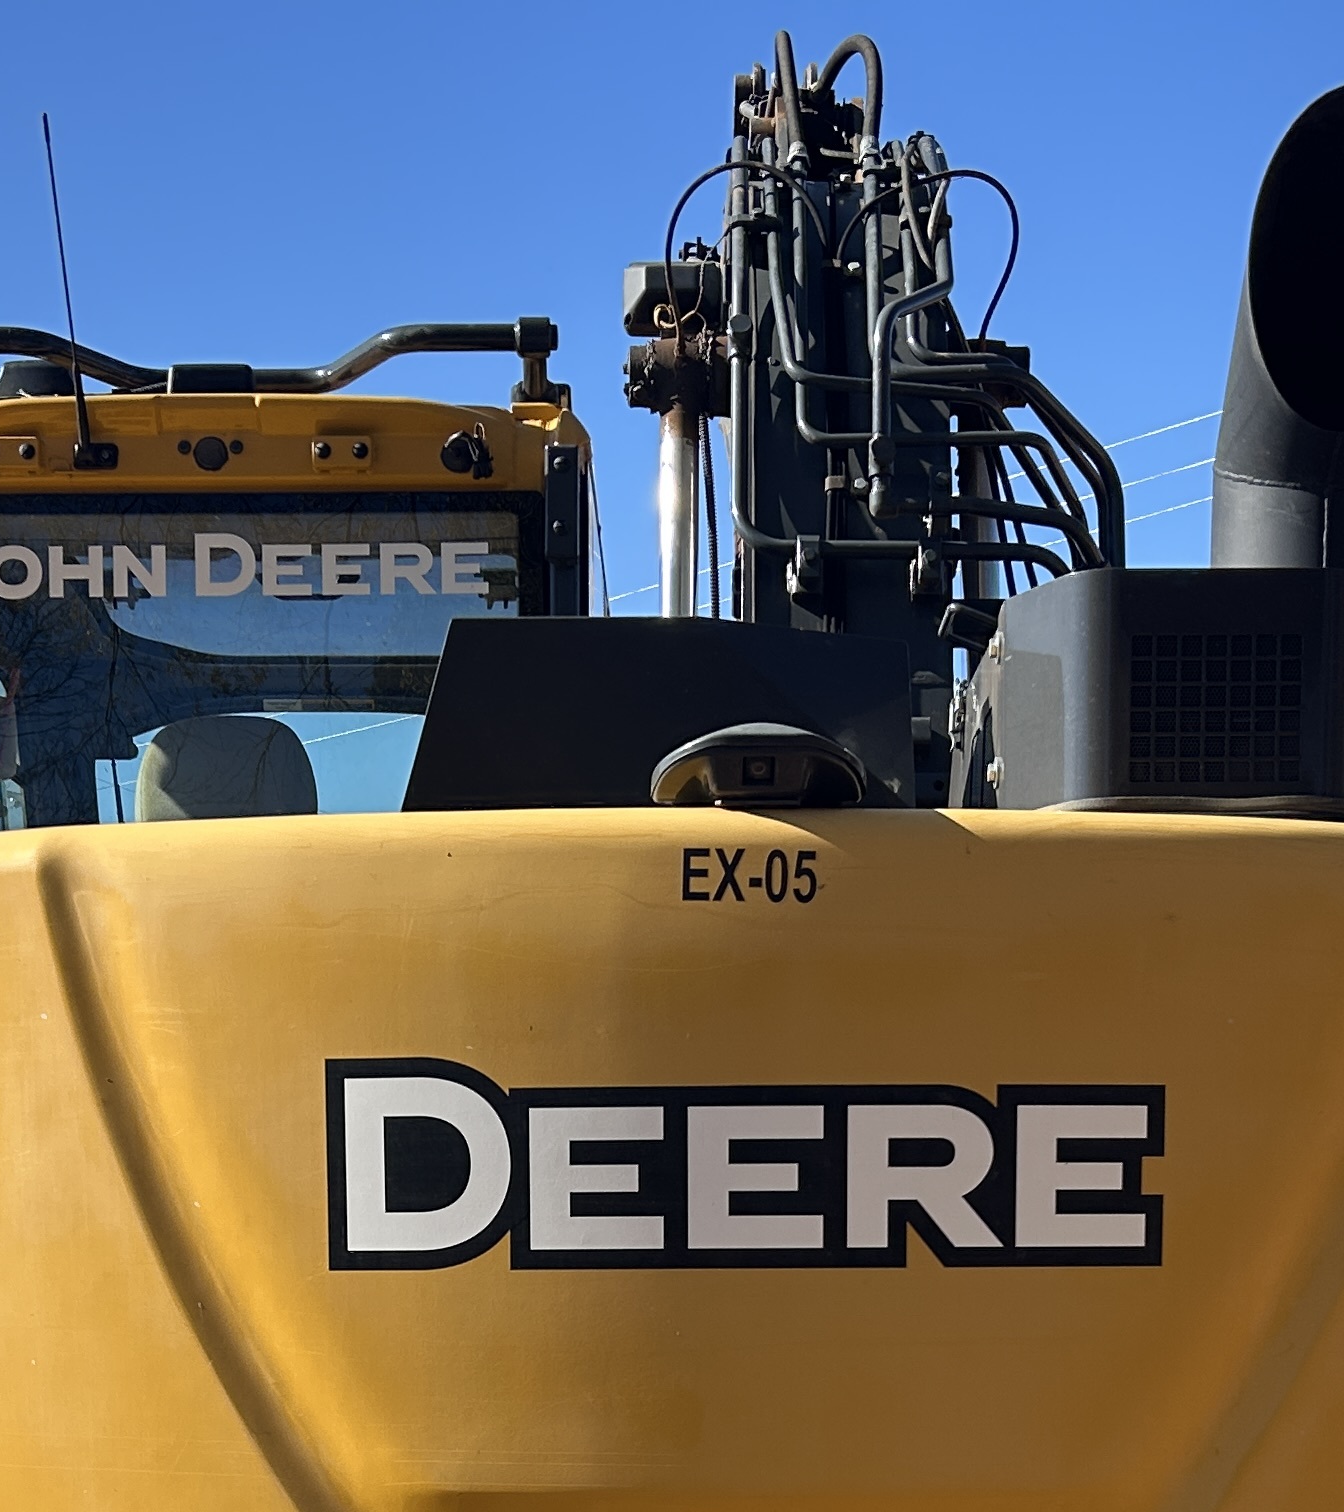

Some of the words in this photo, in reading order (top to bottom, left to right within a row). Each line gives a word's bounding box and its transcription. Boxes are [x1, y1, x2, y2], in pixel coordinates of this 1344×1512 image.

[194, 532, 490, 598] DEERE
[682, 848, 817, 903] EX-05
[342, 1076, 1148, 1252] DEERE
